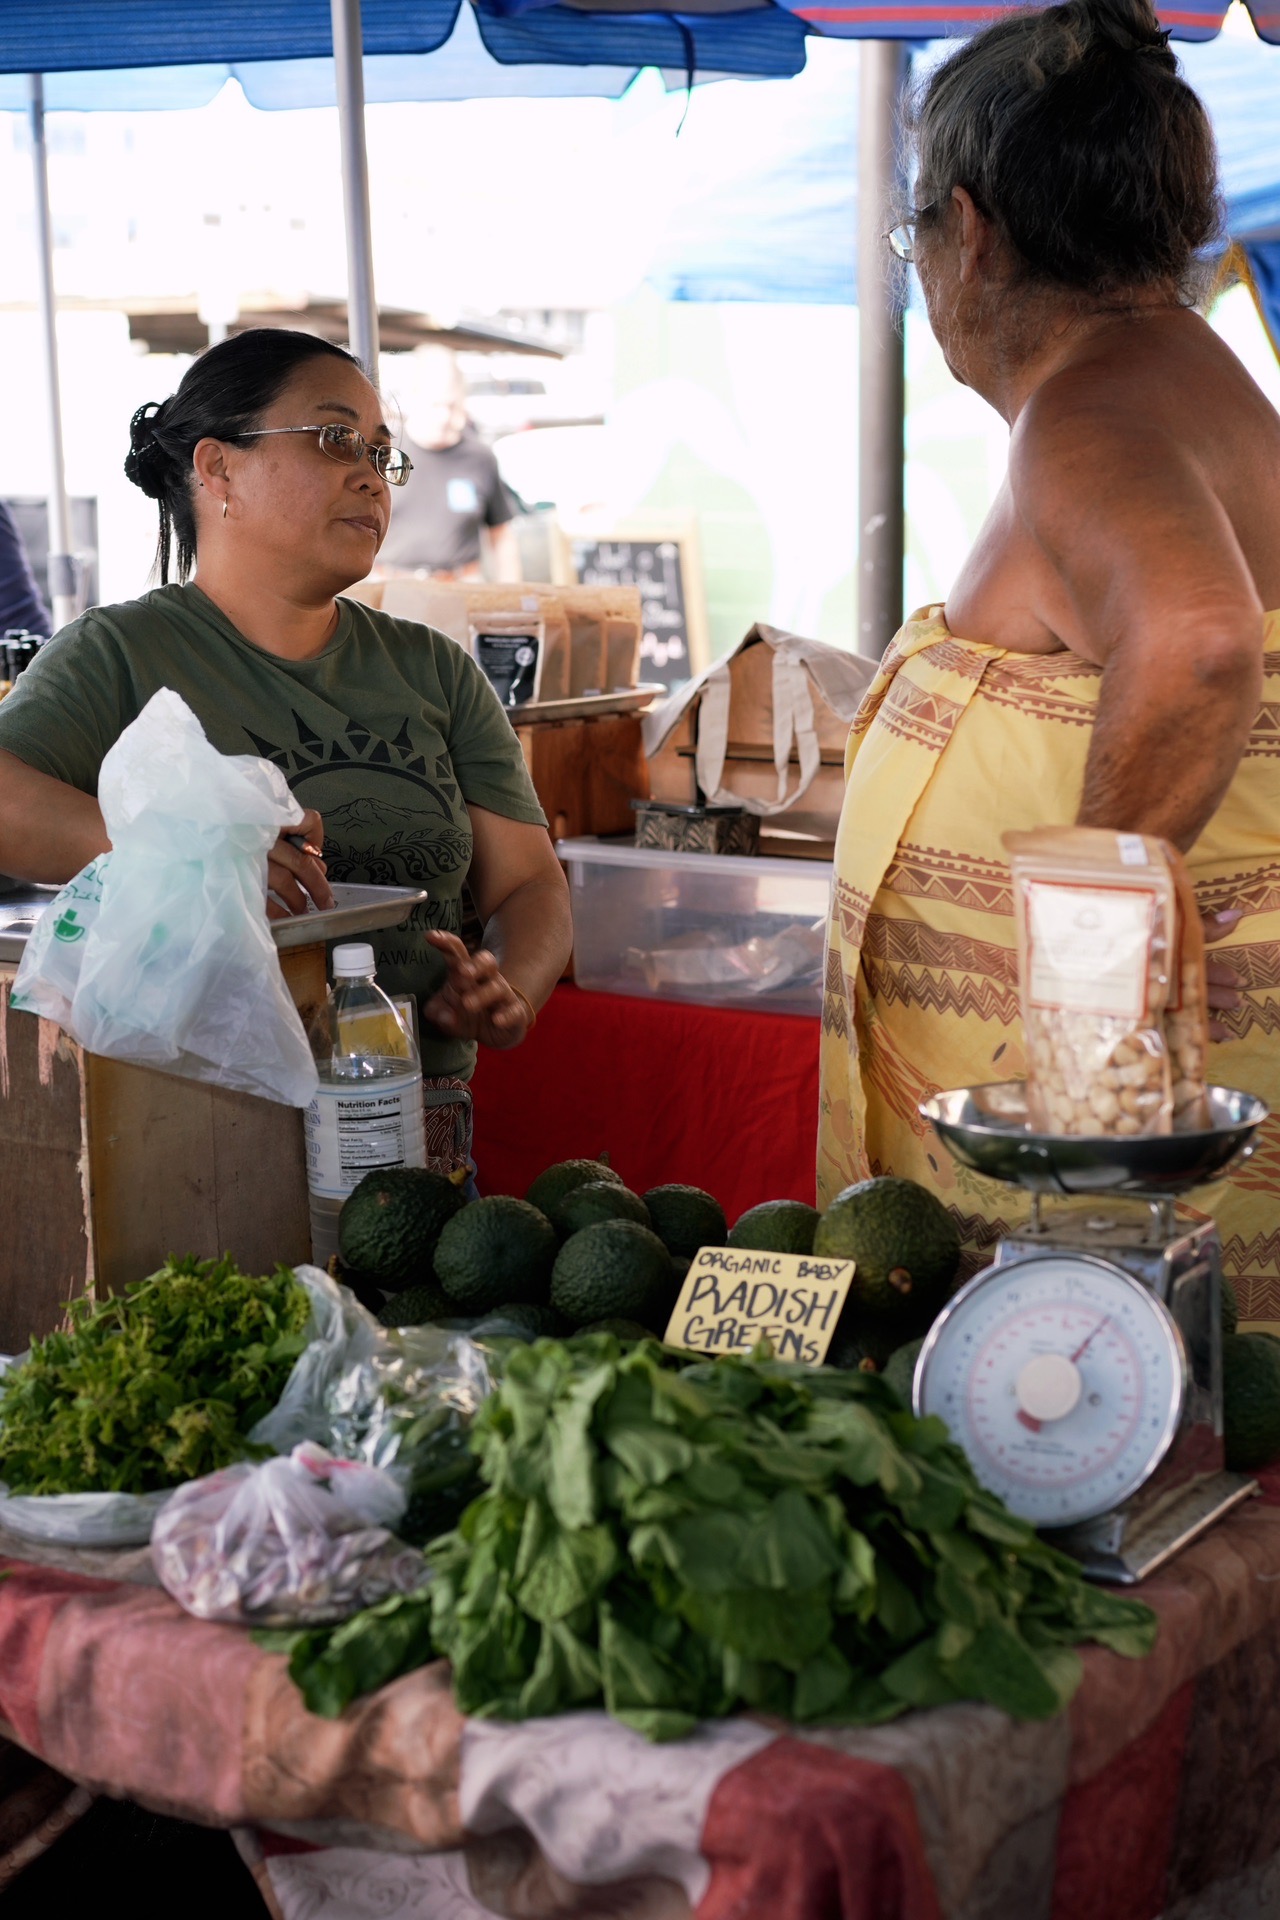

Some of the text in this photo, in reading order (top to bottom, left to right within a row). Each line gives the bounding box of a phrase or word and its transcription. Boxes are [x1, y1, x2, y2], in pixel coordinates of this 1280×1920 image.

[377, 949, 430, 967] AWAII
[338, 1097, 401, 1109] Nutrition Facts
[698, 1252, 849, 1280] ORGANIC BABY
[685, 1274, 838, 1331] RADISH
